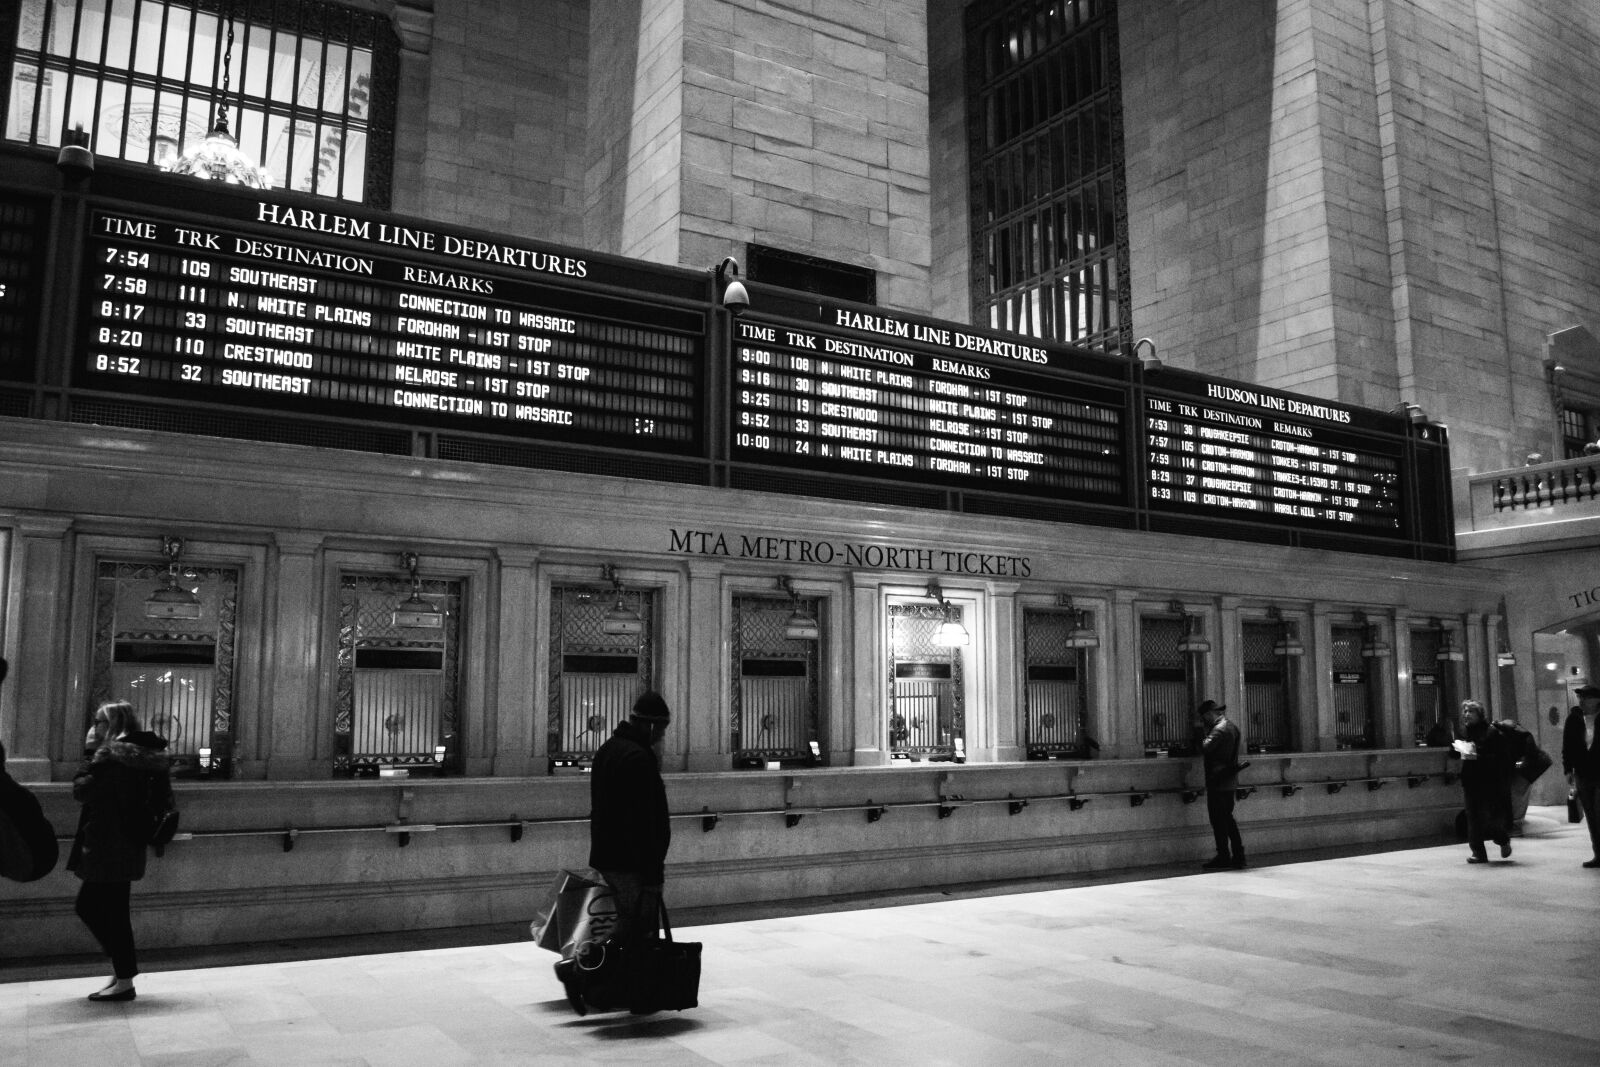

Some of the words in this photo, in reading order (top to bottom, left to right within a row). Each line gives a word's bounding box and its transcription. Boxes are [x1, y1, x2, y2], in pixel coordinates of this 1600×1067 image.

[102, 217, 156, 239] TIME
[175, 228, 220, 250] TRK
[235, 238, 373, 274] DESTINATION
[404, 267, 494, 294] REMARKS
[258, 202, 370, 239] HARLEM
[379, 224, 435, 251] LINE
[444, 236, 587, 277] DEPARTURES
[104, 274, 147, 294] 7:58
[180, 286, 206, 302] 111
[228, 292, 244, 309] N.
[258, 296, 306, 317] WHITE
[316, 304, 371, 326] PLAINS
[398, 317, 460, 339] FORDHAM
[486, 330, 509, 347] 1ST
[518, 336, 551, 352] STOP
[106, 248, 149, 268] 7:54
[182, 259, 210, 278] 109
[230, 267, 317, 294] SOUTHEAST
[399, 294, 486, 320] CONNECTION
[495, 308, 510, 324] TO
[520, 311, 576, 334] WASSAIC
[99, 328, 142, 347] 8:20
[176, 337, 204, 354] 110
[224, 344, 312, 368] CRESTWOOD
[396, 366, 458, 387] MELROSE
[485, 377, 508, 394] 1ST
[517, 383, 550, 399] STOP
[101, 301, 144, 320] 8:17
[185, 312, 206, 328] 33
[226, 318, 314, 343] SOUTHEAST
[397, 342, 441, 362] WHITE
[450, 349, 501, 370] PLAINS
[527, 359, 550, 377] 1ST
[558, 365, 590, 381] STOP
[740, 324, 775, 341] TIME
[787, 332, 816, 349] TRK
[825, 339, 913, 366] DESTINATION
[933, 359, 990, 380] REMARKS
[836, 310, 909, 338] HARLEM
[914, 325, 950, 346] LINE
[955, 333, 1048, 364] DEPARTURES
[97, 354, 140, 374] 8:52
[181, 364, 202, 381] 32
[222, 369, 310, 394] SOUTHEAST
[394, 391, 483, 415] CONNECTION
[491, 402, 508, 418] TO
[516, 405, 573, 425] WASSAIC
[742, 370, 770, 385] 9:16
[796, 379, 808, 392] 30
[822, 382, 877, 403] SOUTHEAST
[930, 399, 958, 414] WHITE
[964, 405, 996, 420] PLAINS
[1012, 413, 1027, 426] 1ST
[1032, 416, 1052, 429] STOP
[743, 349, 770, 364] 9:00
[791, 357, 808, 371] 108
[822, 361, 832, 374] N.
[841, 365, 871, 381] WHITE
[877, 371, 912, 388] PLAINS
[929, 380, 968, 397] FORDHAM
[986, 390, 1000, 402] 1ST
[1006, 394, 1027, 406] STOP
[1208, 384, 1257, 405] HUDSON
[1261, 395, 1285, 411] LINE
[1288, 399, 1350, 423] DEPARTURES
[742, 391, 770, 406] 9:25
[797, 399, 808, 412] 19
[822, 403, 877, 422] CRESTWOOD
[930, 419, 969, 435] MELROSE
[986, 427, 1001, 440] 1ST
[1007, 431, 1028, 444] STOP
[742, 412, 769, 428] 9:52
[796, 419, 809, 432] 33
[822, 423, 877, 442] SOUTHEAST
[930, 438, 986, 457] CONNECTION
[991, 447, 1002, 459] TO
[1007, 449, 1044, 464] WASSAIC
[1148, 399, 1172, 412] TIME
[1178, 404, 1198, 417] TRK
[1204, 408, 1262, 428] DESTINATION
[1274, 422, 1312, 438] REMARKS
[1150, 418, 1168, 431] 7:53
[1201, 427, 1249, 444] POUGHKEEPSIE
[1272, 439, 1319, 456] CROTON-HARMON
[1329, 450, 1339, 459] 1ST
[1342, 452, 1356, 462] STOP
[737, 433, 769, 448] 10:00
[796, 441, 809, 454] 24
[822, 444, 832, 457] N.
[841, 446, 871, 462] WHITE
[878, 452, 913, 467] PLAINS
[930, 457, 970, 474] FORDHAM
[987, 465, 1002, 478] 1ST
[1008, 468, 1029, 480] STOP
[1150, 435, 1168, 448] 7:57
[1201, 444, 1254, 461] CROTON-HARMON
[1272, 455, 1298, 468] YONKERS
[1310, 462, 1319, 472] 1ST
[1323, 464, 1337, 474] STOP
[1151, 452, 1169, 465] 7:59
[1202, 460, 1254, 478] CROTON-HARMON
[1345, 482, 1354, 492] 1ST
[1358, 484, 1371, 494] STOP
[1152, 470, 1169, 482] 8:29
[1203, 477, 1251, 493] POUGHKEEPSIE
[1274, 487, 1321, 502] CROTON-HARMON
[1332, 496, 1342, 506] 1ST
[1345, 498, 1359, 507] STOP
[1152, 487, 1170, 499] 8:33
[1204, 494, 1256, 509] CROTON-HARMON
[1275, 503, 1297, 515] MARBLE
[1301, 507, 1315, 517] HILL
[1326, 510, 1336, 519] 1ST
[1339, 512, 1353, 522] STOP
[668, 529, 730, 556] MTA
[740, 535, 933, 570] METRO-NORTH
[941, 551, 1031, 577] TICKETS
